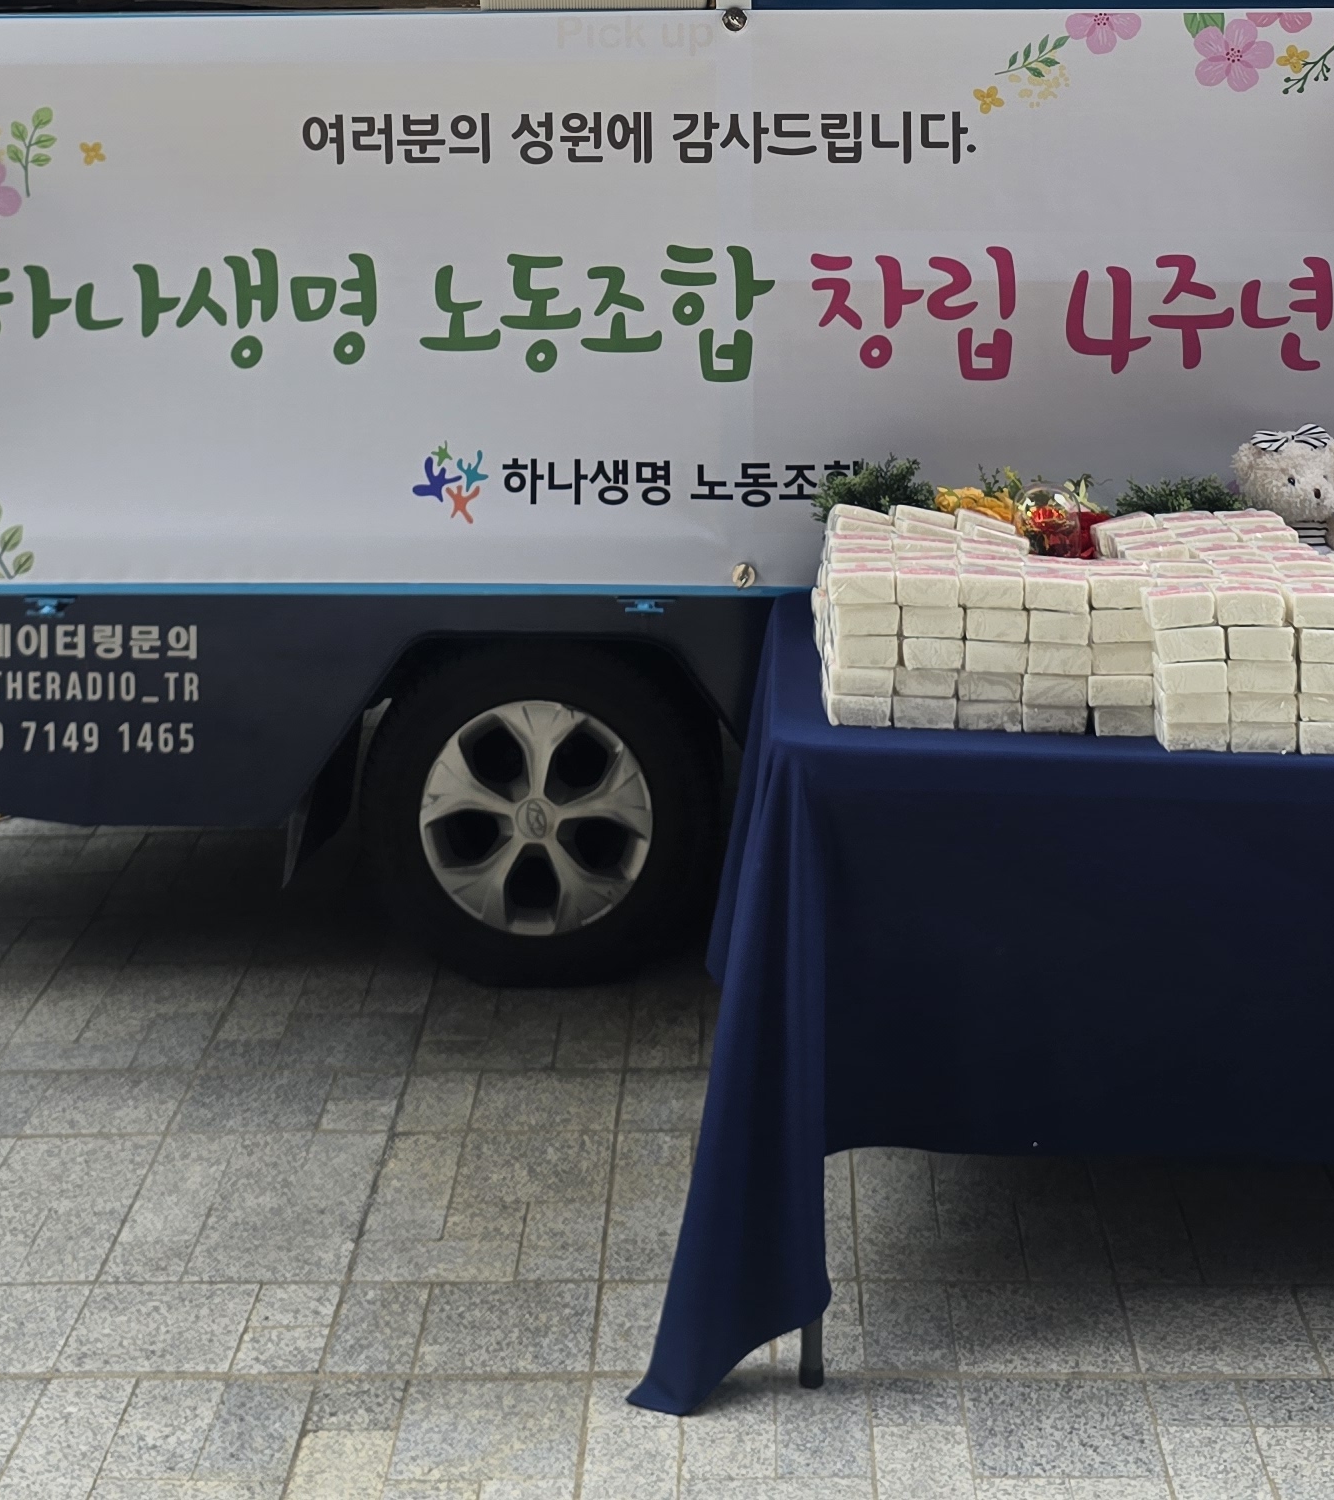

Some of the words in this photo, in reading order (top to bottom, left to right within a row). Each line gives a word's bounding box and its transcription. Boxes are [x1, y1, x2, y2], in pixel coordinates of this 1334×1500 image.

[301, 112, 492, 166] 여러분의
[510, 111, 653, 165] 성원에
[671, 110, 977, 165] 감사드립니다.
[418, 244, 776, 383] 노동조합
[810, 245, 1017, 381] 창립
[1065, 253, 1334, 375] 4주년
[501, 457, 672, 506] 하나생명
[20, 721, 100, 754] 7149
[117, 722, 195, 755] 1465
